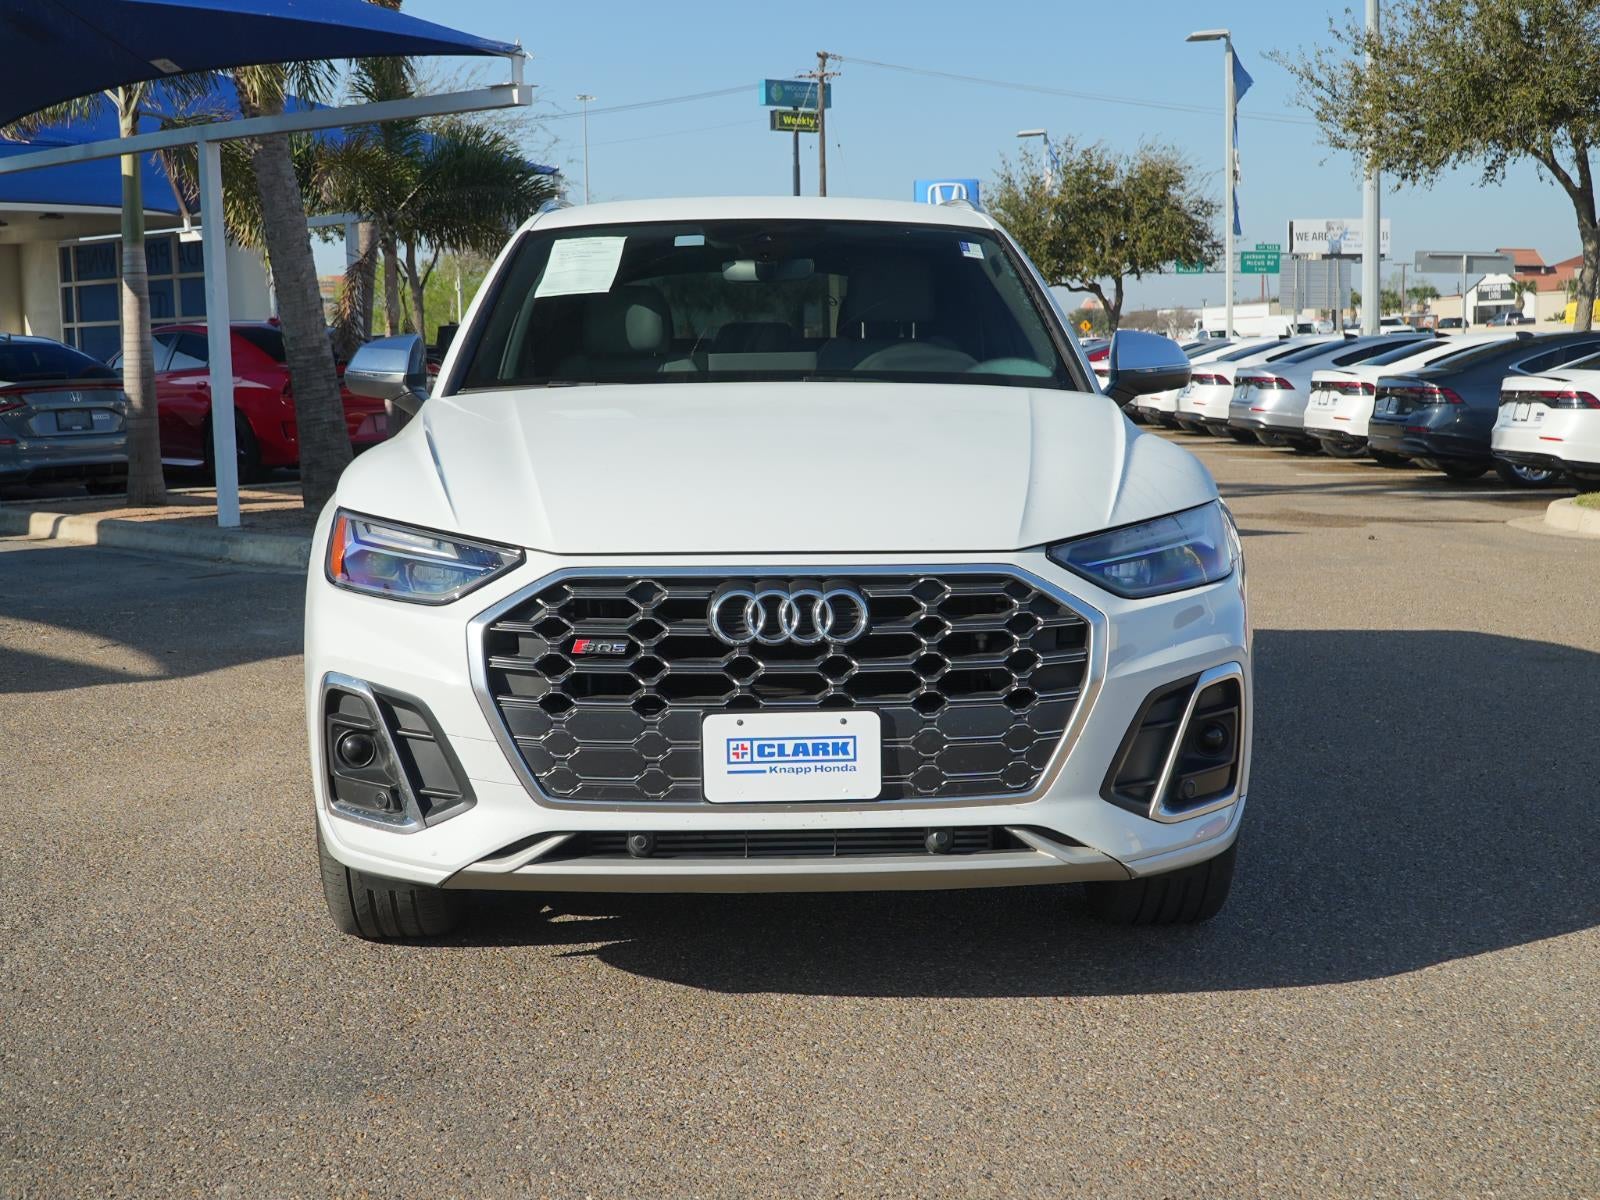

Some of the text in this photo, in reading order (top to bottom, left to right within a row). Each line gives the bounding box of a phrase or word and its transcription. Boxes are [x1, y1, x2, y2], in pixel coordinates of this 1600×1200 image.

[783, 115, 814, 127] Weekly
[1295, 232, 1310, 241] WE
[757, 742, 850, 758] CLARK
[769, 764, 857, 775] Knapp Honda
